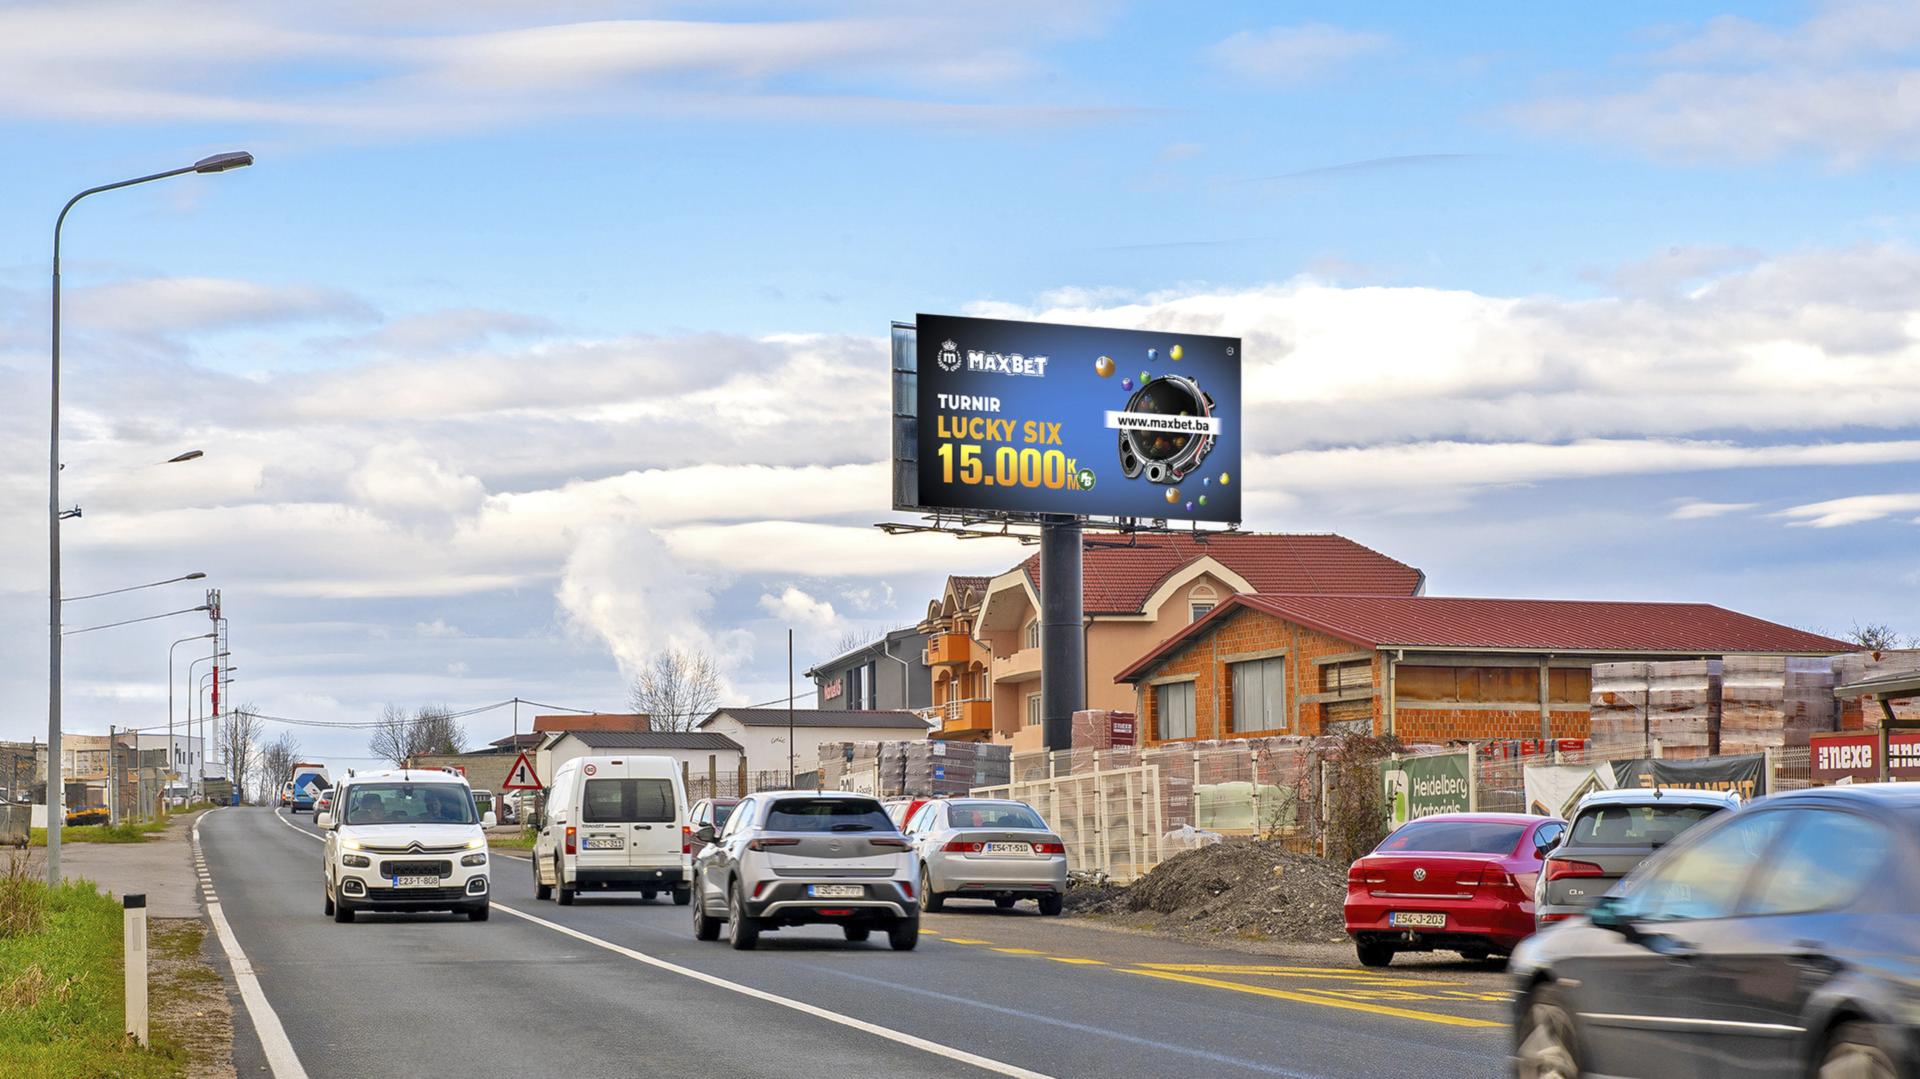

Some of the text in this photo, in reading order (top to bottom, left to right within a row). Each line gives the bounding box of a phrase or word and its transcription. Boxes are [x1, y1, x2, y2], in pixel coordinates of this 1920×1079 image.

[967, 350, 1048, 377] MAXBET
[937, 393, 1001, 412] TURNIR
[937, 415, 1063, 445] LUCKY SIX
[1117, 416, 1209, 431] www.maxbet.ba
[938, 443, 1066, 489] 15.000
[1829, 744, 1872, 769] nexe
[1413, 774, 1468, 799] Heidelberg
[1395, 913, 1444, 925] E54-J-203
